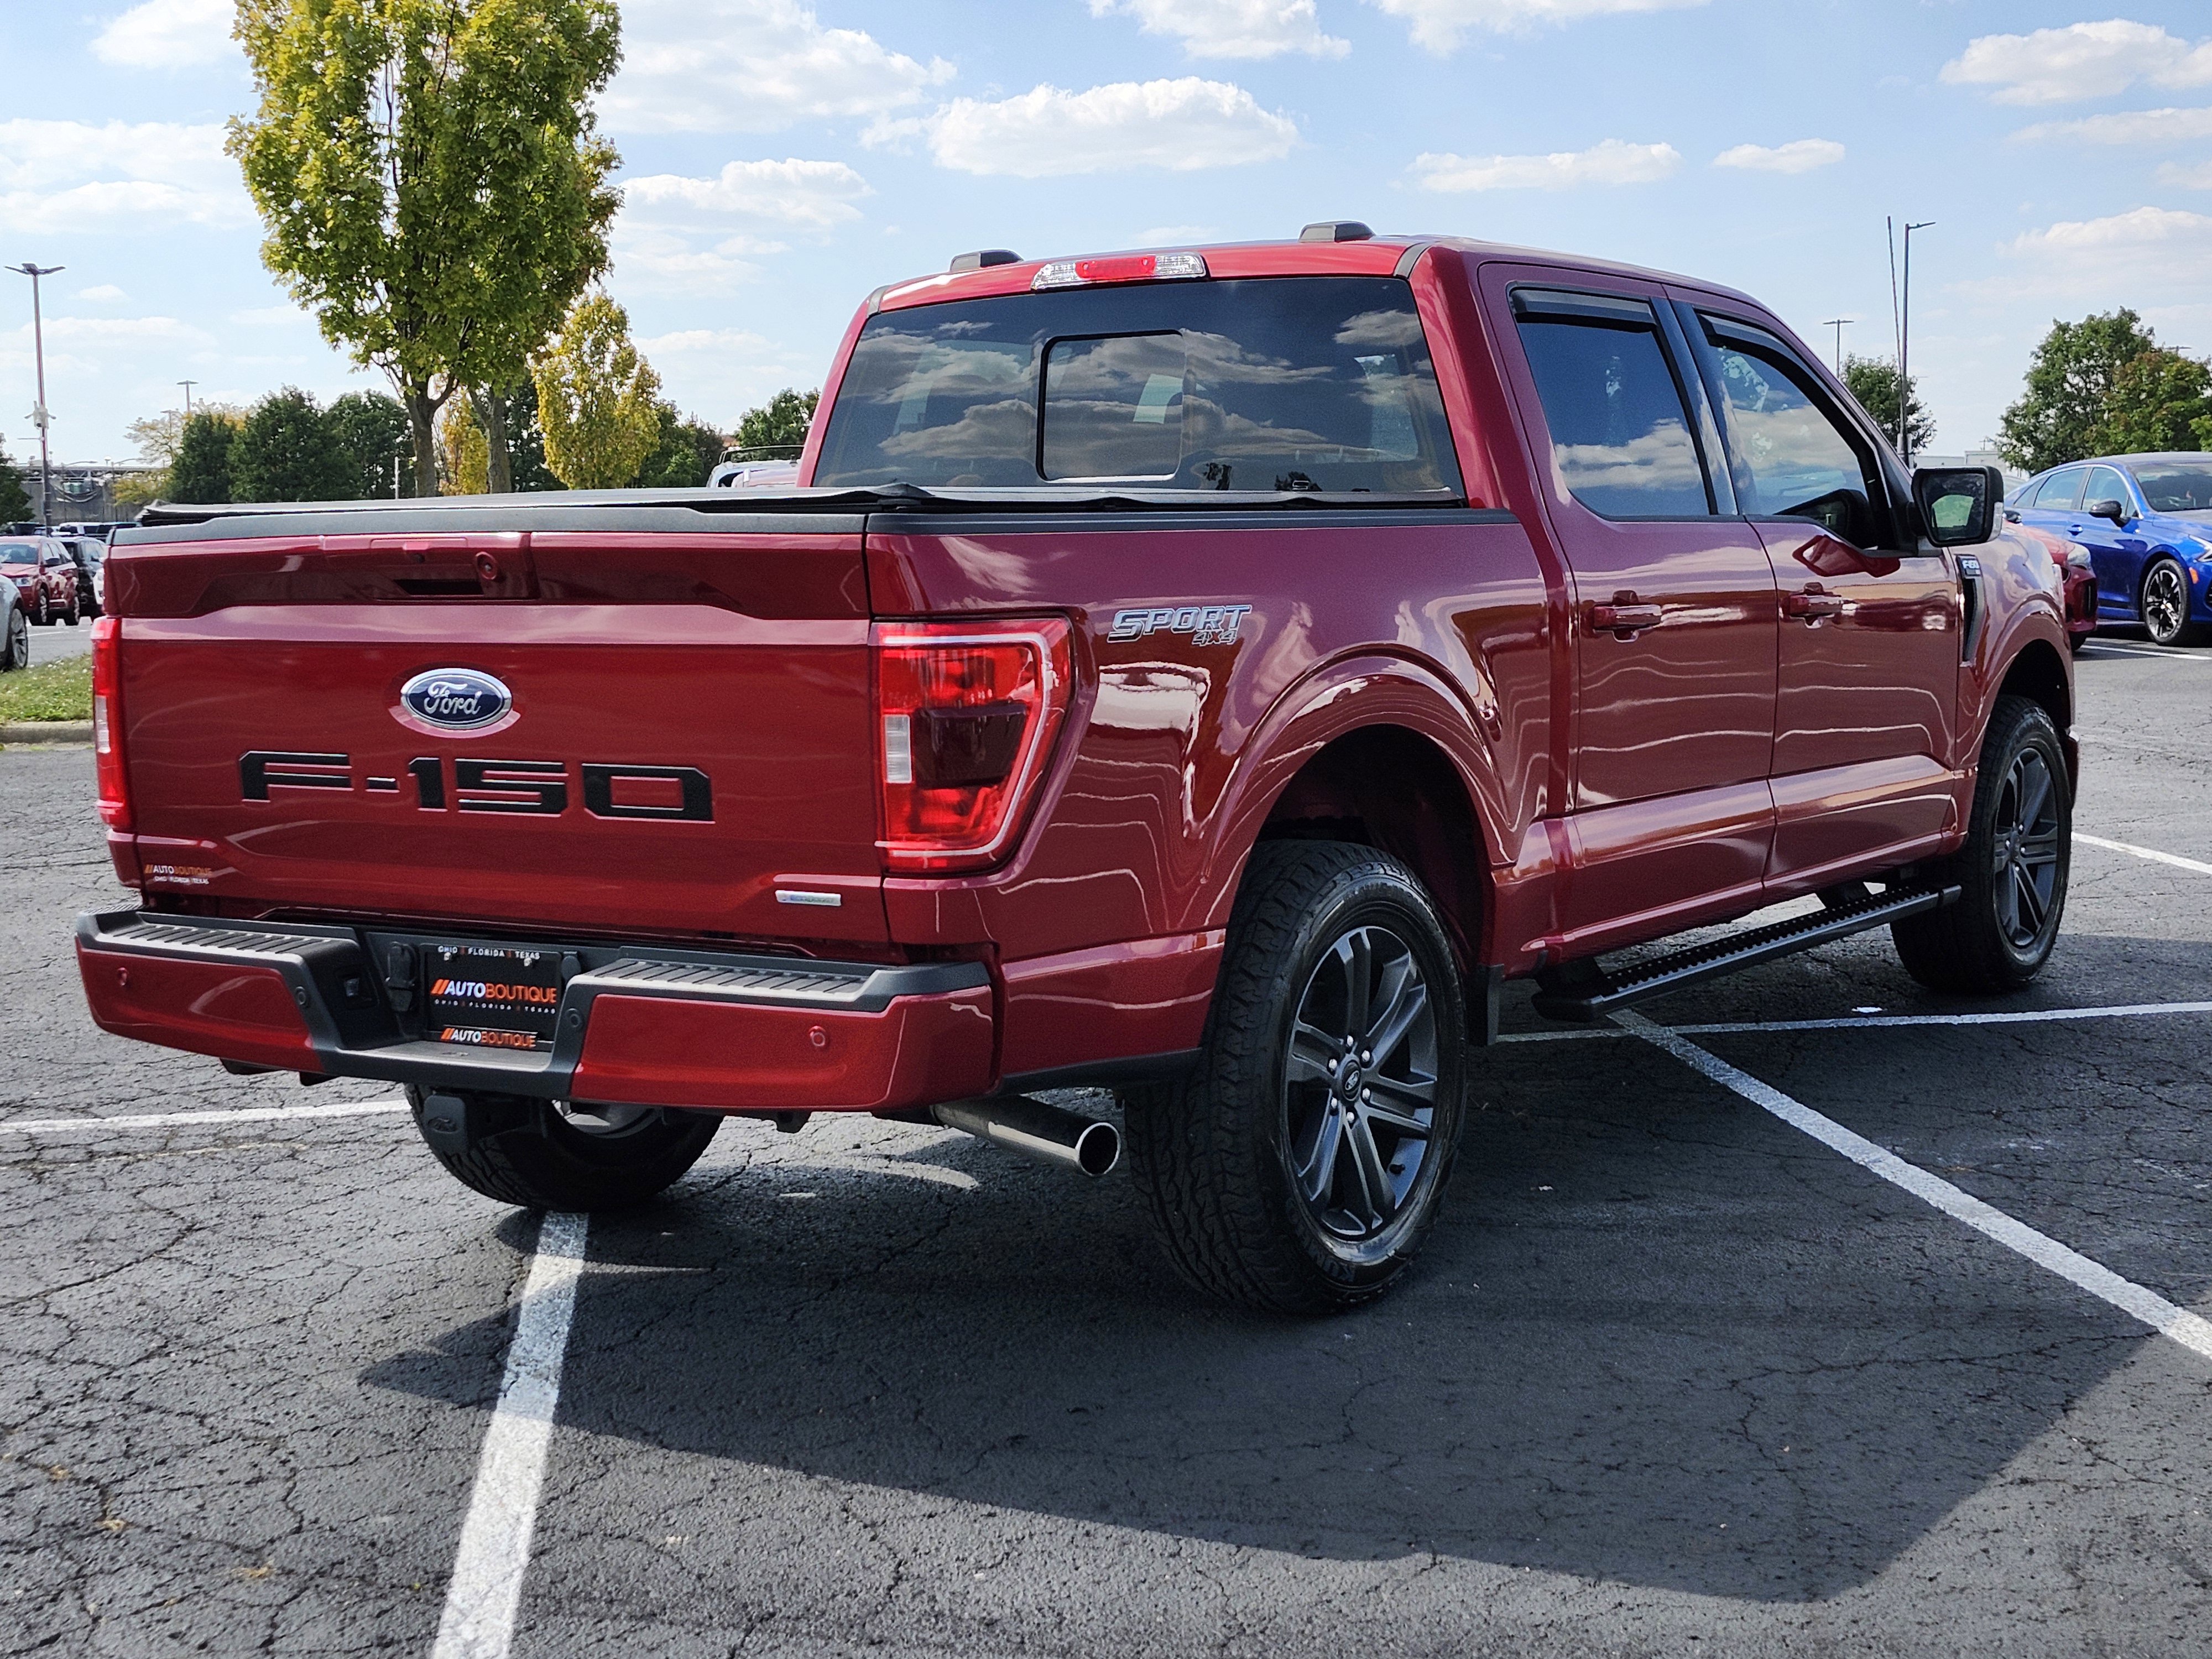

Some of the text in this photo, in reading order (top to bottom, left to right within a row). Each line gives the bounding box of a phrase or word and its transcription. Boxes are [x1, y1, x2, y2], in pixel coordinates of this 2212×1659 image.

[1107, 604, 1252, 643] SPORT
[424, 681, 483, 715] Ford
[238, 750, 716, 824] F-150
[468, 948, 505, 957] FLORIDA
[515, 951, 540, 959] TEXAS
[445, 980, 557, 1003] AUTOBOUTIQUE
